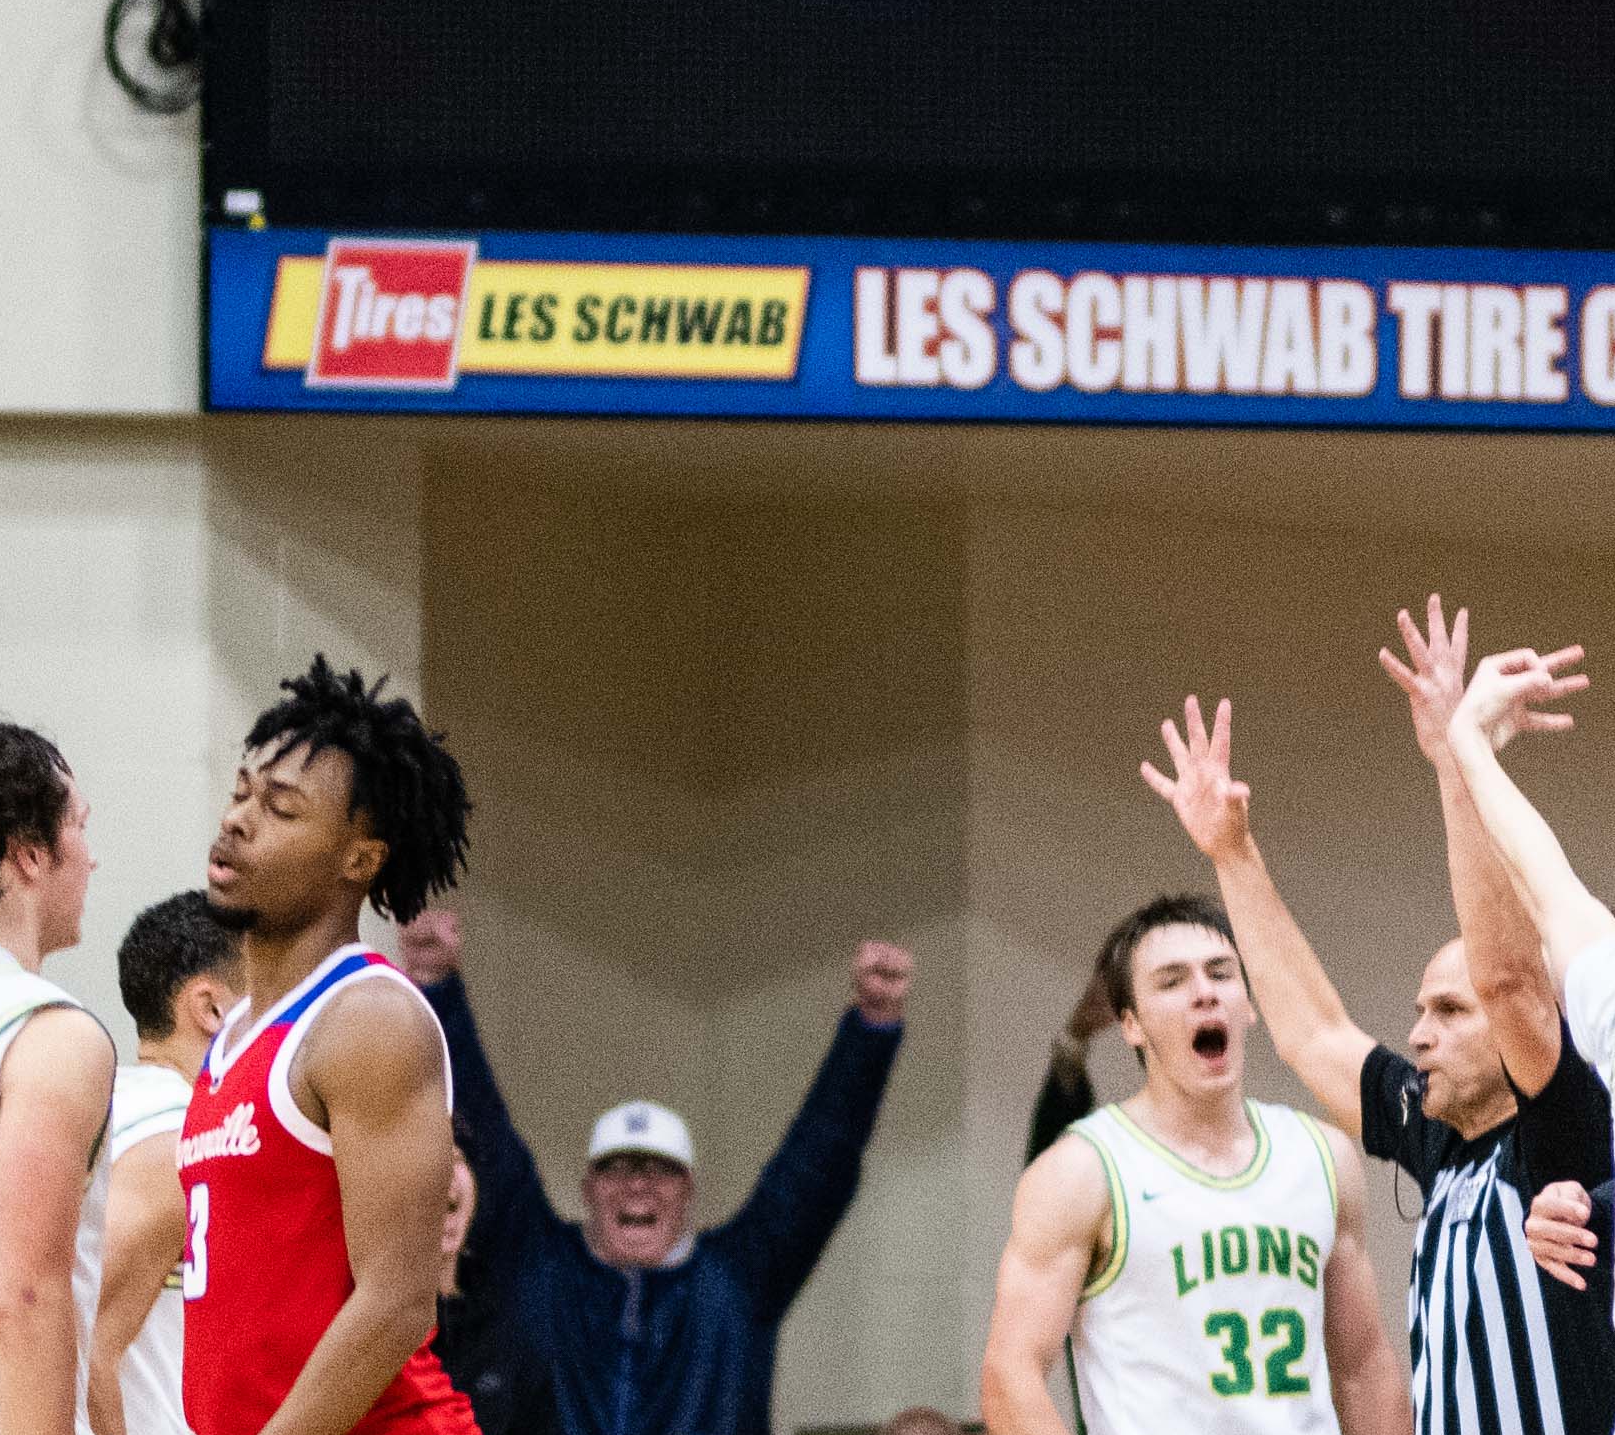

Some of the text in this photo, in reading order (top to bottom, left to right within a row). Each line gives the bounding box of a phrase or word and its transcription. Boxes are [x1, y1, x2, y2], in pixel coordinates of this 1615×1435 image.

[334, 265, 457, 352] Tires
[478, 292, 788, 348] LES SCHWAB
[853, 266, 995, 391] LES
[1009, 270, 1376, 399] SCHWAB
[1388, 281, 1570, 403] TIRE
[1171, 1224, 1320, 1298] LIONS
[1203, 1305, 1313, 1398] 32
